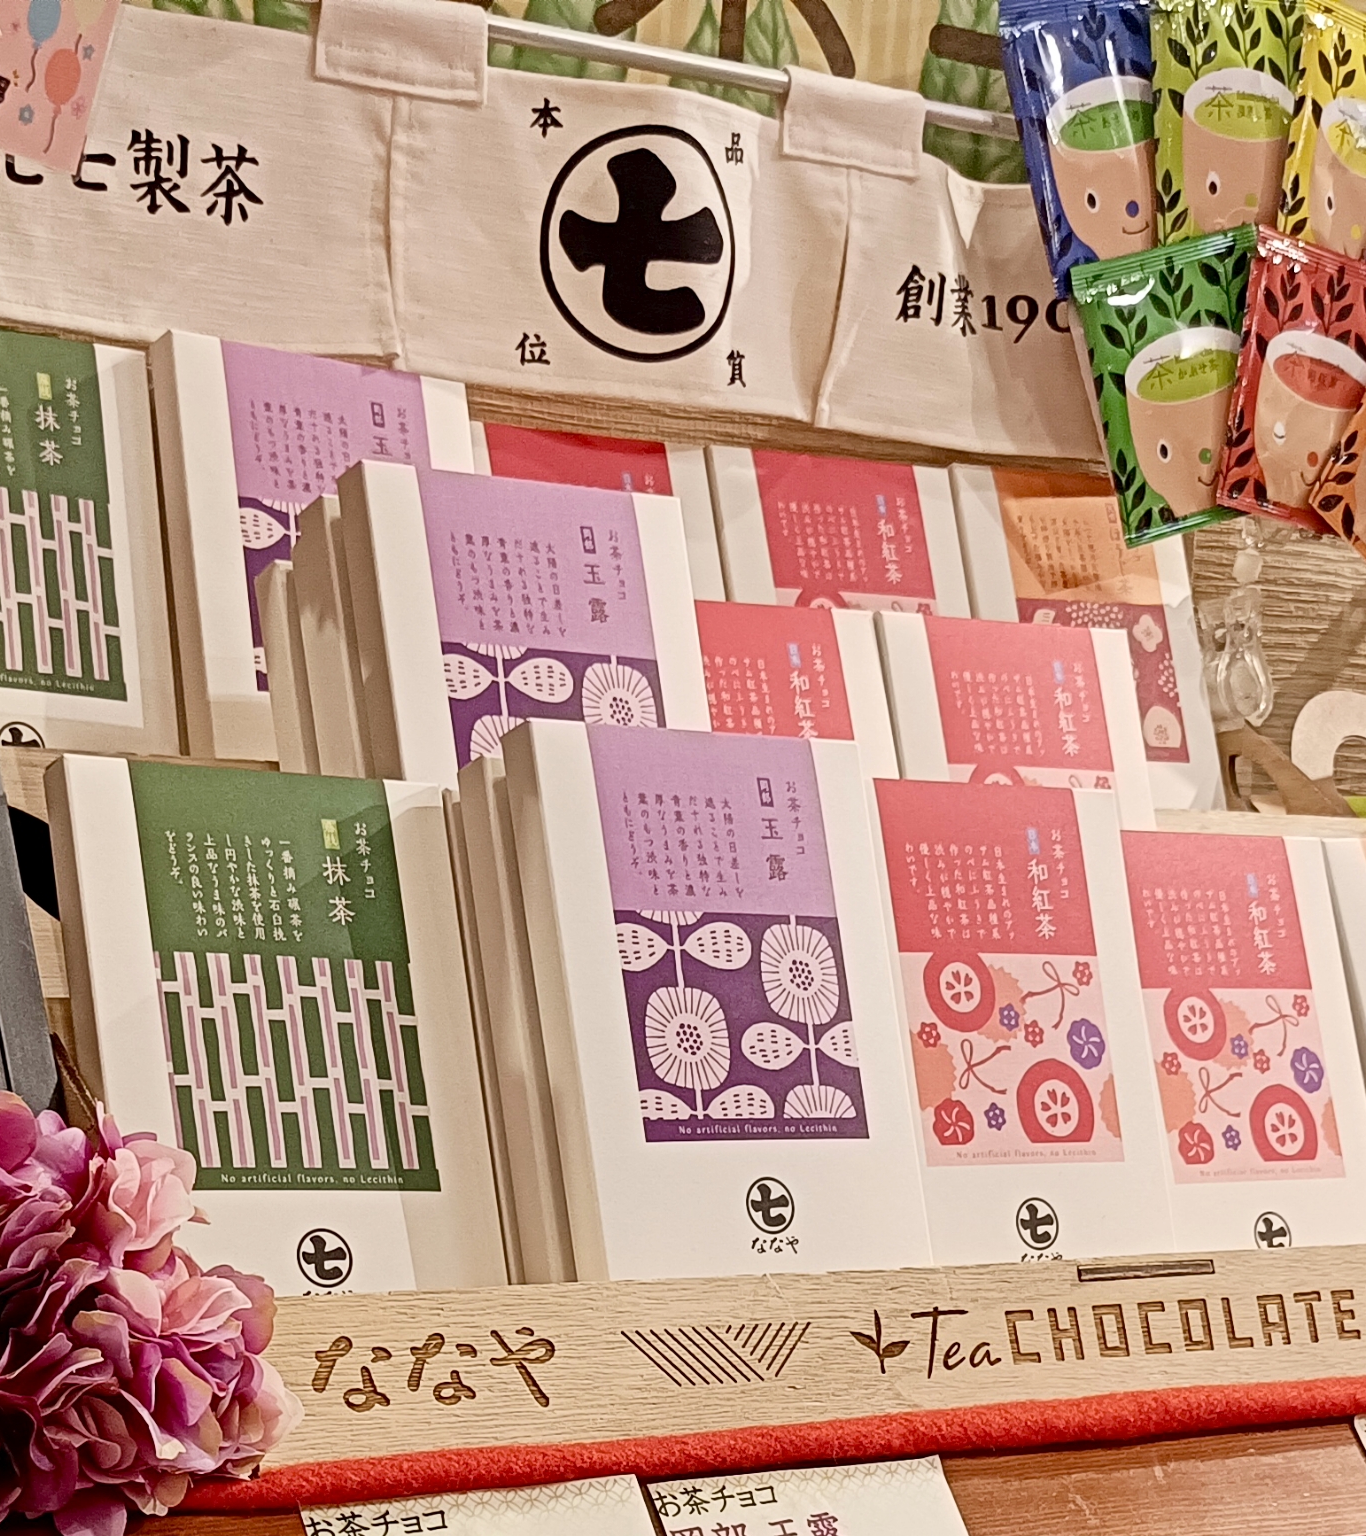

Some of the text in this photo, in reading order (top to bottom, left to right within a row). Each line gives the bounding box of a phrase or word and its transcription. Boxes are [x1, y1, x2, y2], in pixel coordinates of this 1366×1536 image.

[530, 98, 563, 136] 本
[725, 132, 743, 166] 品
[516, 333, 551, 366] 位
[726, 350, 747, 388] 質
[35, 404, 64, 466] 抹茶
[876, 518, 903, 585] 和紅茶
[583, 564, 610, 625] 玉露
[789, 670, 819, 737] 和紅茶
[1053, 686, 1081, 757] 和紅茶
[761, 818, 787, 881] 玉露
[786, 781, 805, 855] お茶チョコ
[322, 855, 356, 926] 抹茶
[354, 822, 376, 899] お茶チョコ
[1051, 829, 1069, 899] お茶チョコ
[1027, 859, 1056, 940] 和紅茶
[1248, 901, 1276, 975] 和紅茶
[679, 1125, 692, 1134] No
[696, 1124, 741, 1135] artificial
[800, 1123, 838, 1134] Lecithin
[221, 1173, 236, 1184] No
[241, 1172, 292, 1184] artificial
[343, 1174, 356, 1184] no
[360, 1174, 404, 1185] Lecithin
[751, 1236, 800, 1255] ななや
[314, 1327, 555, 1412] ななや
[911, 1307, 1001, 1378] Tea
[1005, 1289, 1362, 1365] CHOCOLATE
[653, 1485, 778, 1518] お茶チョコ
